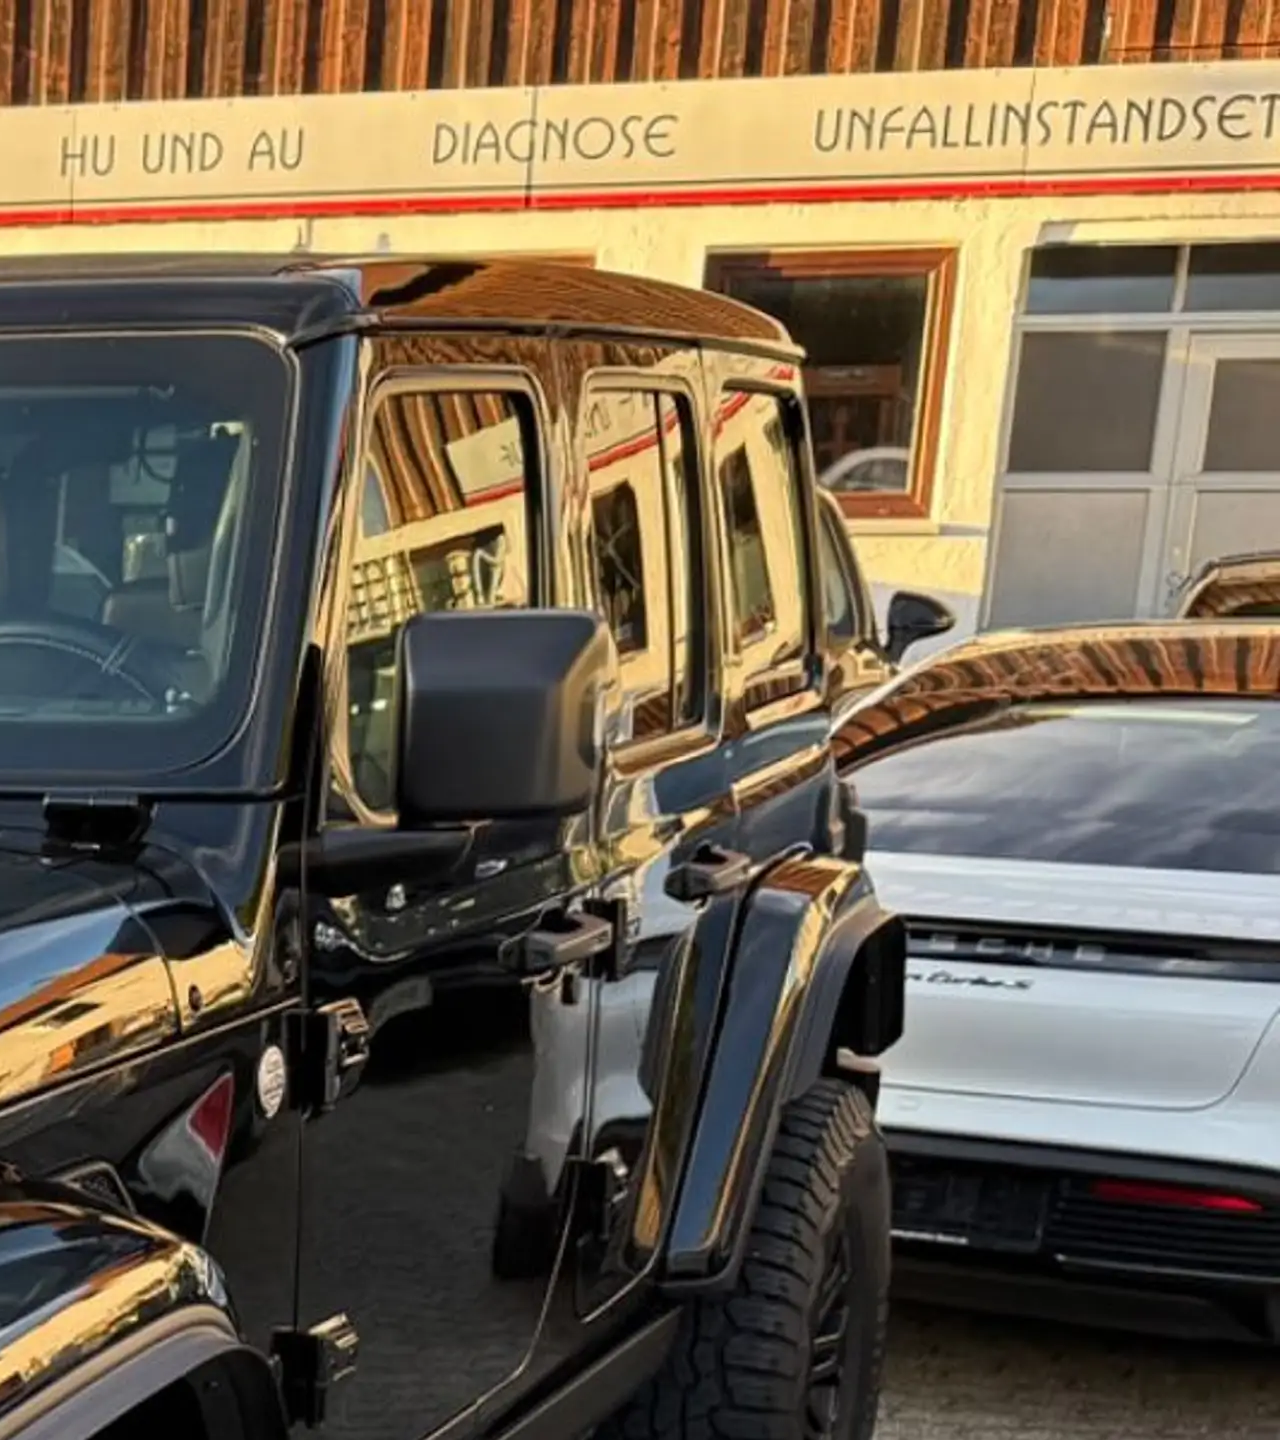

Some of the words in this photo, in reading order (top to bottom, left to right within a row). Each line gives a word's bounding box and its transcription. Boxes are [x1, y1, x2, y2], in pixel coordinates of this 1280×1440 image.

[433, 113, 680, 165] DIAGNOSE
[814, 94, 1280, 153] UNFALLINSTANDSET
[60, 133, 116, 178] HU
[142, 130, 224, 174] UND
[248, 127, 305, 172] AU
